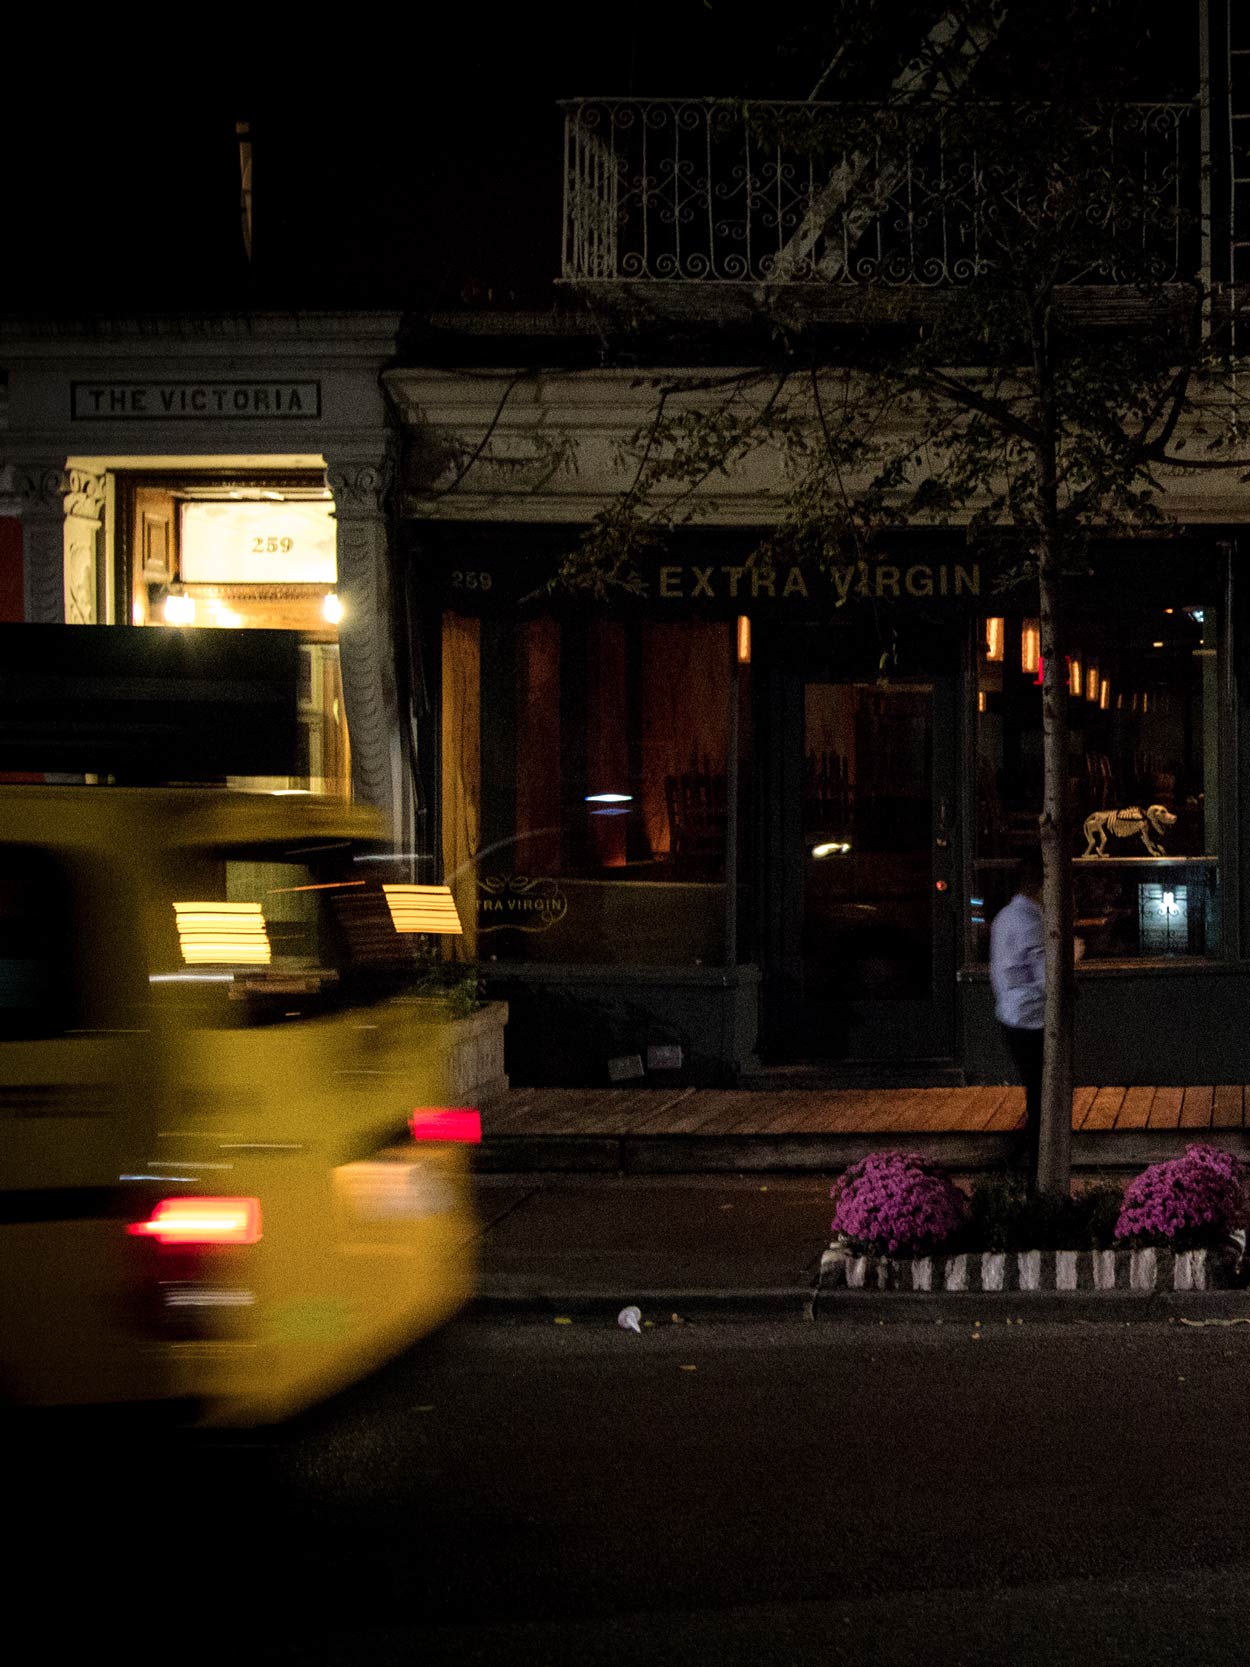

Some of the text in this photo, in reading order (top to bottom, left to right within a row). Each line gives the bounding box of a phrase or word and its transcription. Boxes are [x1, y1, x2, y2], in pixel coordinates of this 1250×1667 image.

[89, 389, 302, 411] THE VICTORIA
[252, 536, 294, 554] 259
[450, 570, 493, 590] 259
[659, 564, 981, 598] EXTRA VIRGIN
[507, 899, 561, 911] VIRGIN
